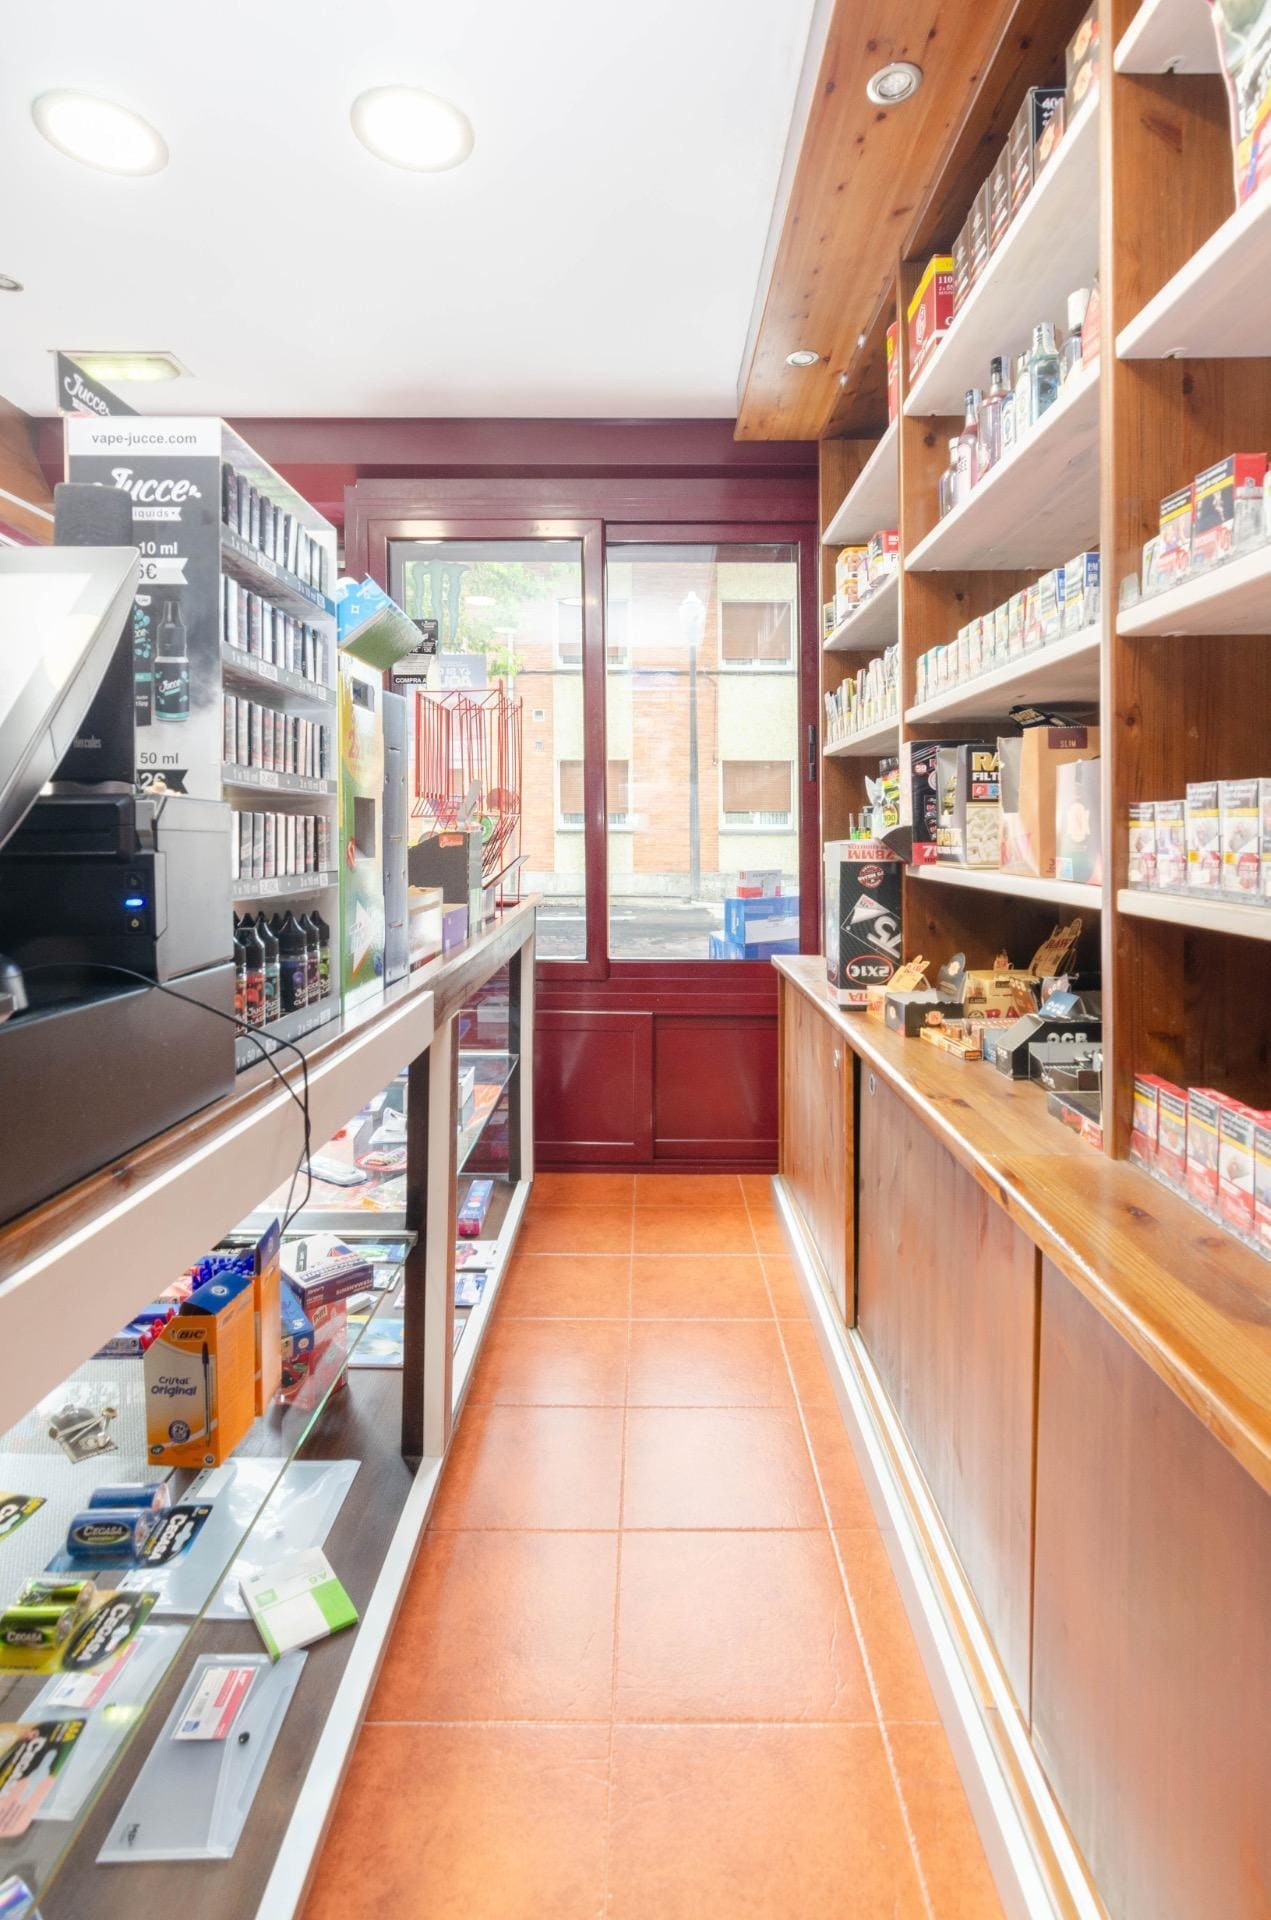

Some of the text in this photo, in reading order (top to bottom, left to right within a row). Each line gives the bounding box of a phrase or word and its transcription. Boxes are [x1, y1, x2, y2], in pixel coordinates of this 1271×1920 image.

[92, 431, 197, 446] vape-jucce.com
[139, 541, 178, 555] 10 ml
[1060, 739, 1077, 748] SLIM
[140, 752, 179, 765] 50 ml
[1047, 1032, 1088, 1043] OCB
[177, 1330, 204, 1339] BIC
[158, 1376, 189, 1385] Cristal
[151, 1385, 197, 1398] Original
[148, 1514, 189, 1560] CEGASA
[76, 1603, 132, 1661] CEGASA
